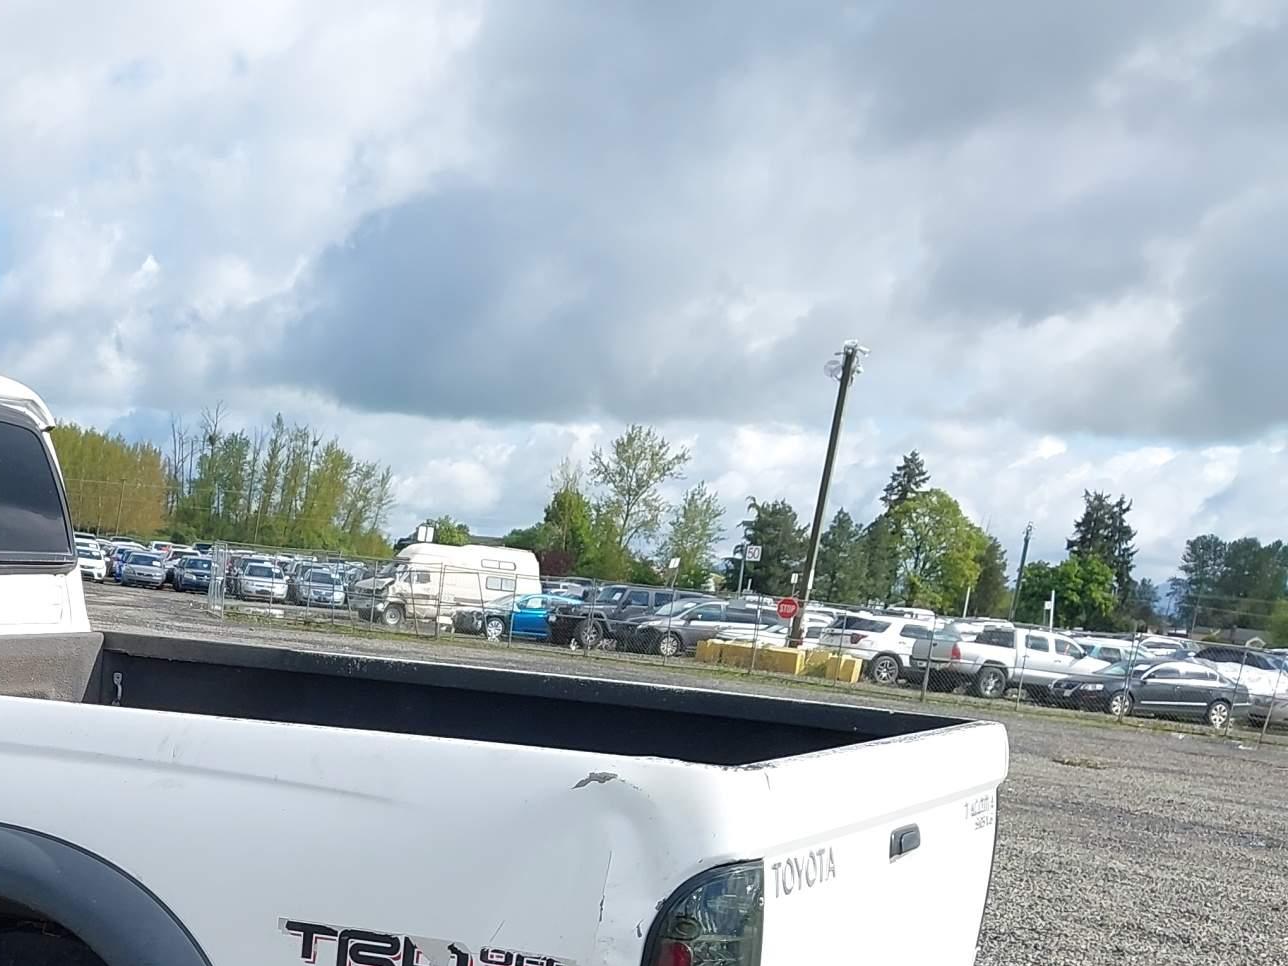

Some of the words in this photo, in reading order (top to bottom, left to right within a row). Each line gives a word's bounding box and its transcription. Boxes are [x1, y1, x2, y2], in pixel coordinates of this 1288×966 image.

[747, 547, 760, 559] 50
[779, 604, 795, 613] STOP
[771, 846, 836, 899] TOYOTA
